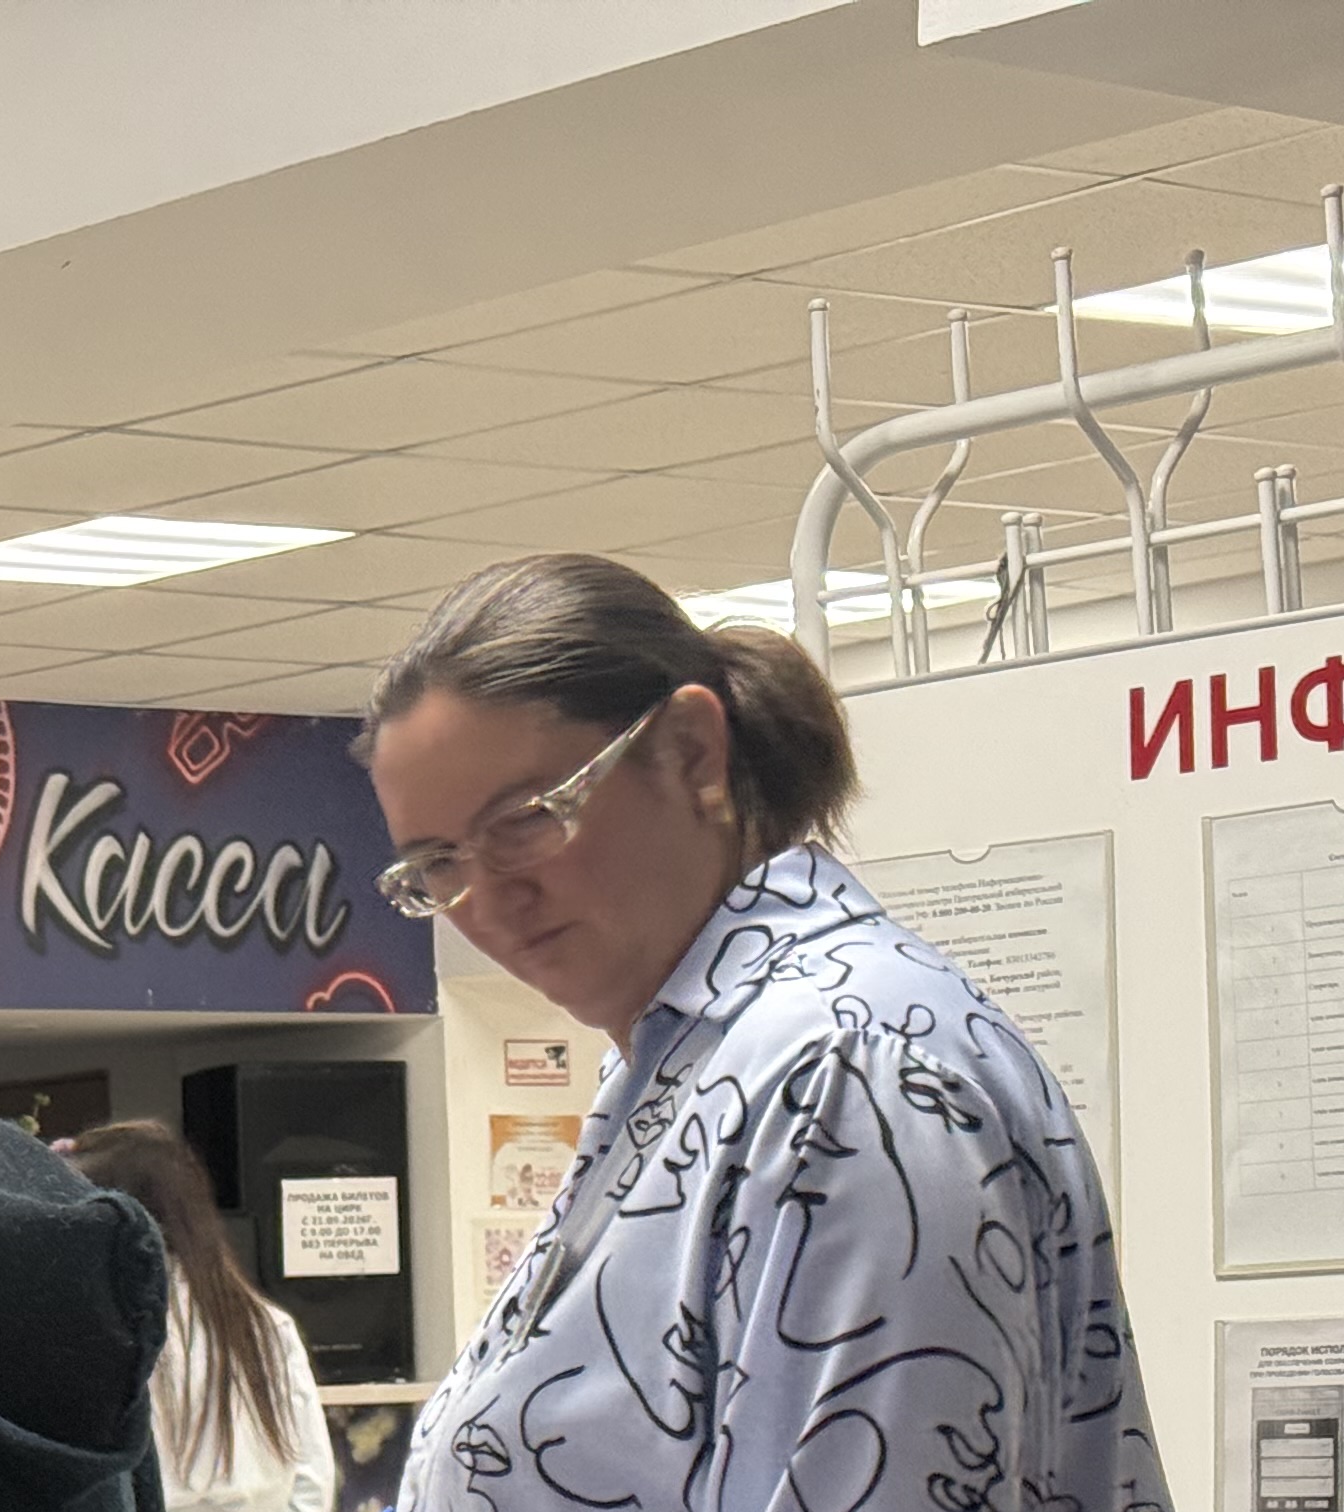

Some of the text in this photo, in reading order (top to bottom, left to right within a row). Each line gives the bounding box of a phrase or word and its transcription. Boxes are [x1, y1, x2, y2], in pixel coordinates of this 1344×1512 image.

[1129, 655, 1344, 781] ИНФ
[21, 772, 348, 949] Касса
[287, 1191, 390, 1203] ПРОДАЖА БИЛЕТОВ
[317, 1204, 363, 1214] НА ЦИРК
[335, 1227, 350, 1237] ДО
[301, 1238, 378, 1249] БЕЗ ПЕРЕРЫВА
[1260, 1347, 1309, 1357] ПОРЯДОК
